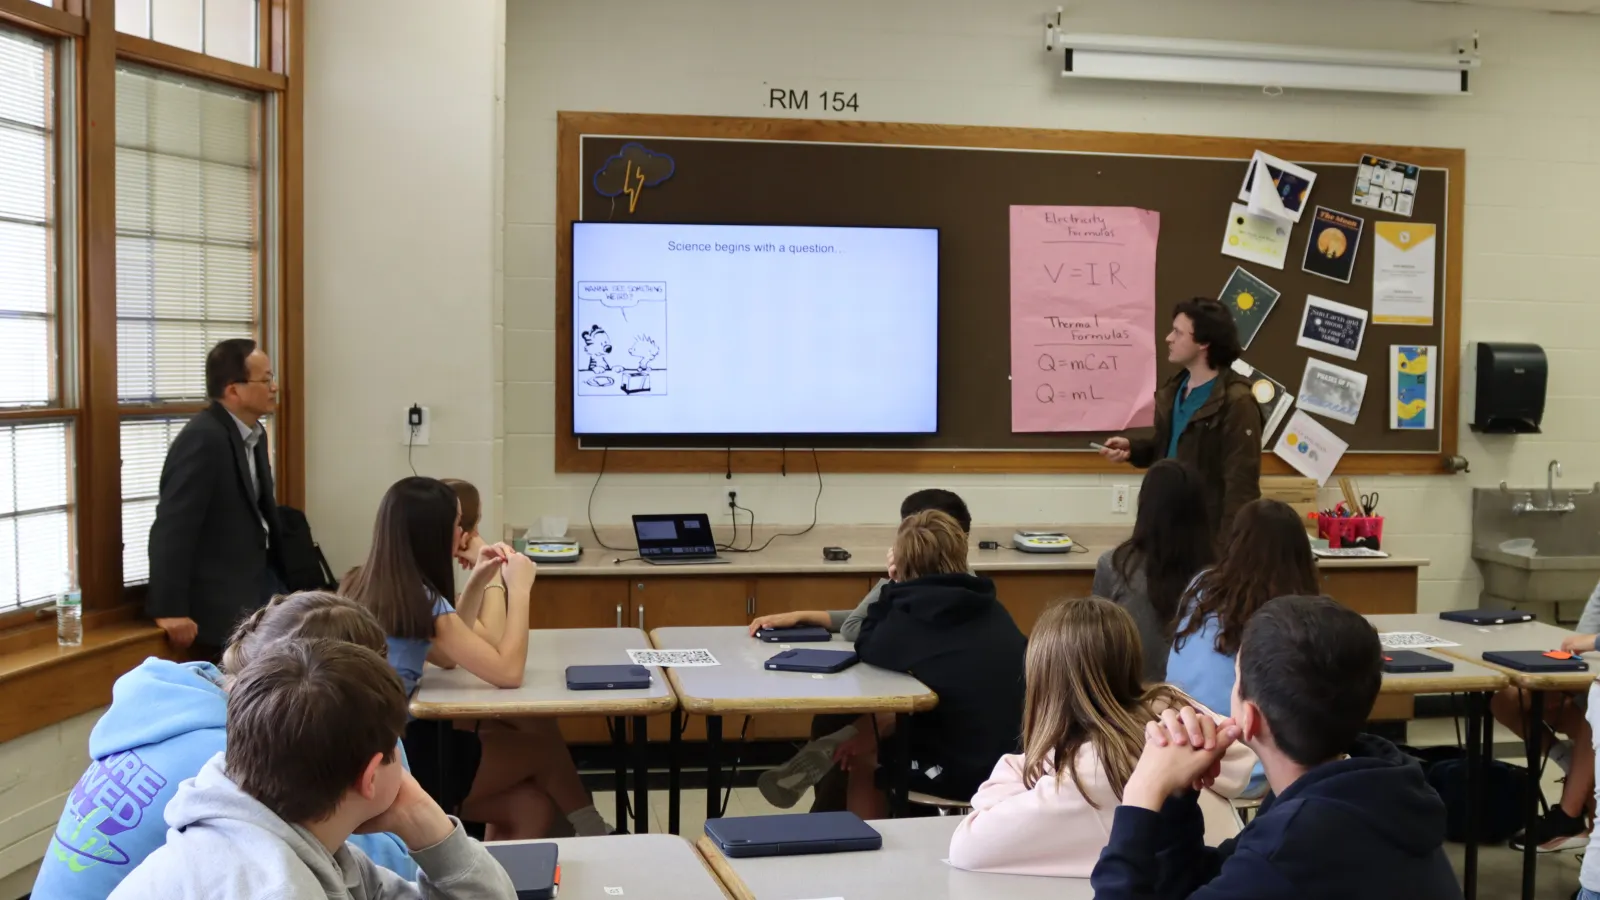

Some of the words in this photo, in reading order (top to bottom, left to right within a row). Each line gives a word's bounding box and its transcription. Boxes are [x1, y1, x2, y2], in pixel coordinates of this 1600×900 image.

[769, 88, 808, 110] RM
[819, 90, 860, 112] 154
[1044, 212, 1107, 230] Electricity
[1067, 226, 1115, 238] Formulas
[667, 240, 712, 252] Science
[714, 241, 751, 255] begins
[753, 242, 776, 253] with
[778, 243, 786, 253] a
[1044, 313, 1100, 329] Thermal
[1071, 329, 1130, 341] Formulas
